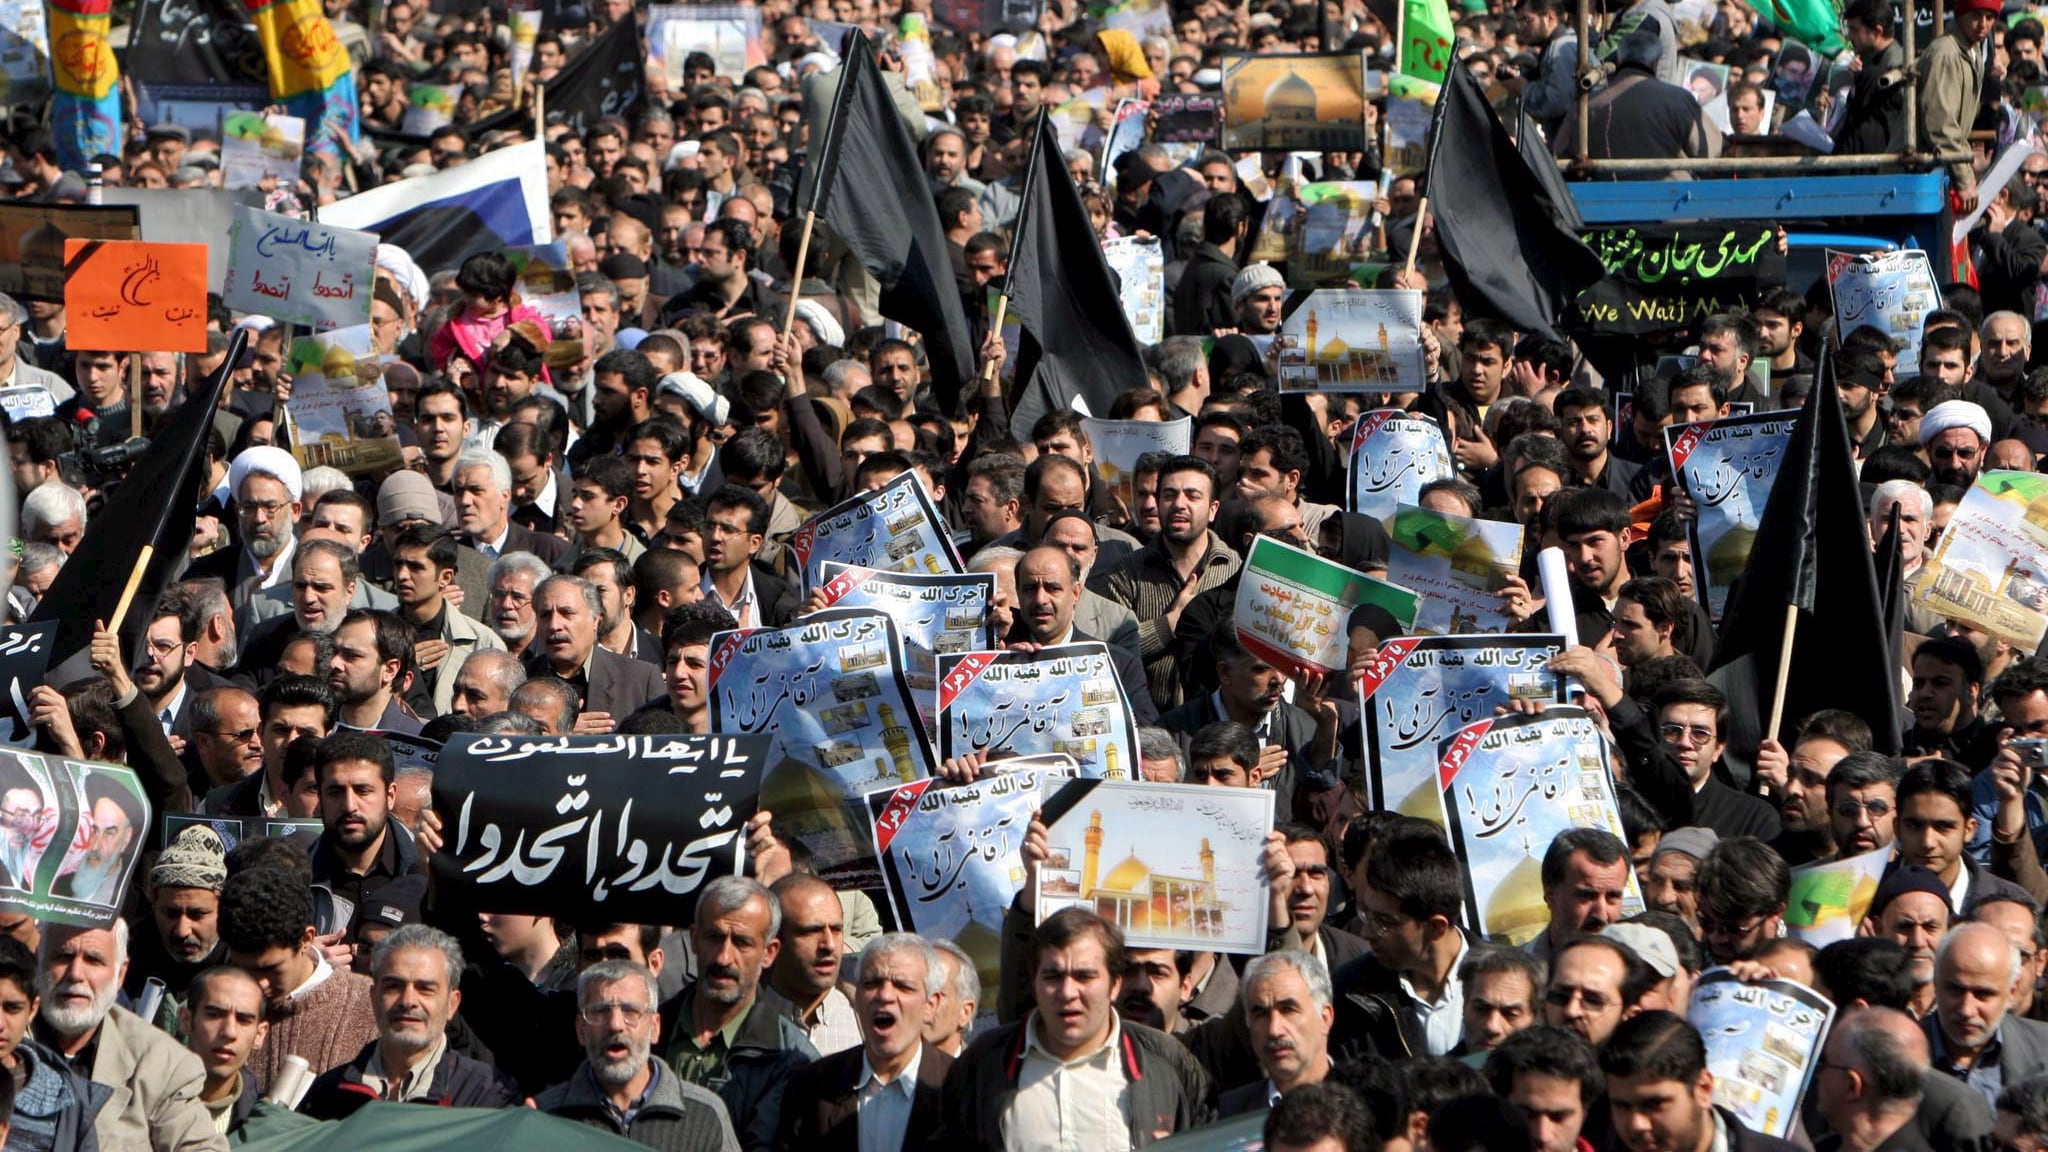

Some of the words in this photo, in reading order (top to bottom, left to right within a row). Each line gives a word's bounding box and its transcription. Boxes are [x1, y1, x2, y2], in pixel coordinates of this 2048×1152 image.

[1637, 231, 1701, 283] جان
[1696, 230, 1772, 278] مهدی
[1706, 431, 1726, 442] الله
[1760, 423, 1780, 435] الله
[1753, 448, 1777, 479] آقا
[855, 503, 874, 521] الله
[816, 522, 833, 539] الله
[920, 586, 941, 601] الله
[800, 625, 827, 644] الله
[714, 642, 737, 668] زهرا
[742, 635, 762, 655] الله
[1050, 660, 1072, 676] الله
[1366, 653, 1397, 680] زهرا
[1406, 651, 1433, 668] الله
[1473, 650, 1500, 667] الله
[793, 656, 824, 708] آقا
[943, 665, 973, 691] زهرا
[983, 665, 1009, 681] الله
[1033, 689, 1070, 733] آقا
[1460, 682, 1494, 722] آقا
[1552, 722, 1568, 737] الله
[1481, 731, 1509, 750] الله
[1442, 740, 1473, 769] زهرا
[991, 774, 1015, 795] الله
[1543, 757, 1570, 800] آقا
[919, 793, 946, 812] الله
[880, 802, 910, 830] زهرا
[983, 811, 1015, 862] آقا
